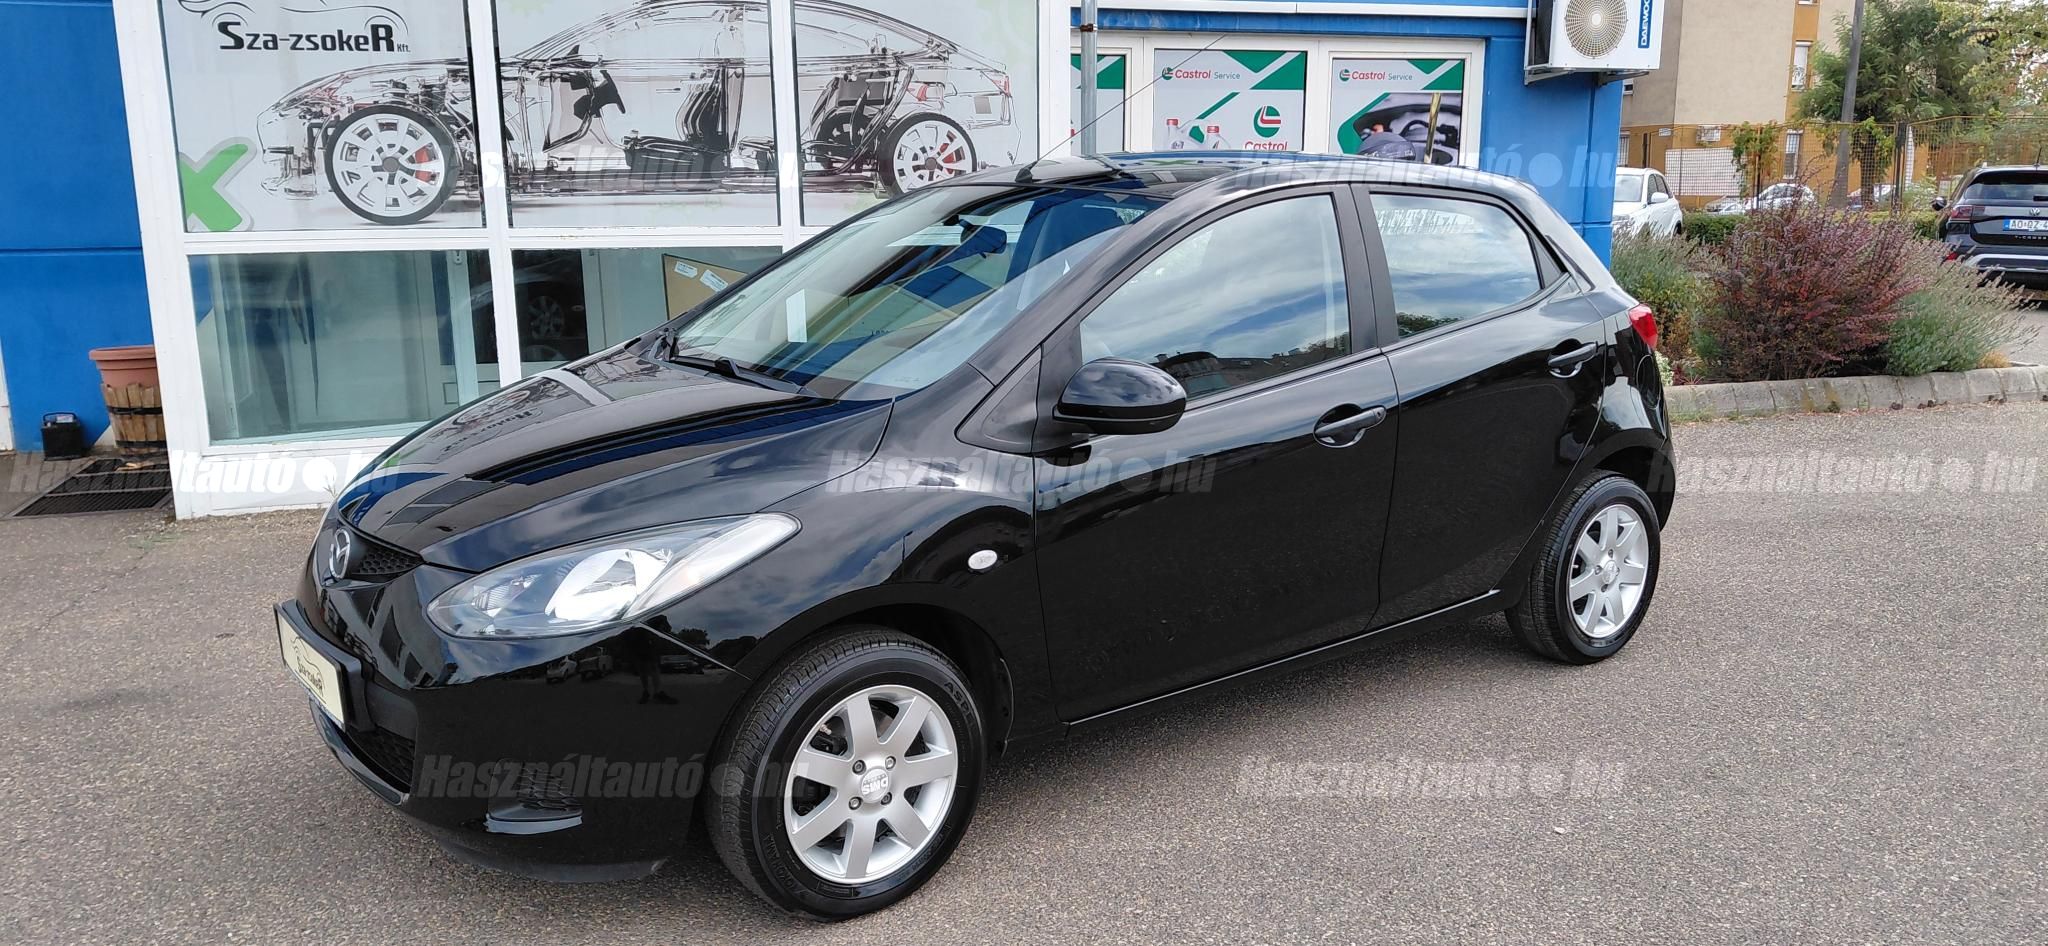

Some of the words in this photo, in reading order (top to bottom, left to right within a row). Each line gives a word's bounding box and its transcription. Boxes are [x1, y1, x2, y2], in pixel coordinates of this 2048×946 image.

[217, 21, 395, 52] Sza-zsokeR
[397, 43, 411, 53] Kft.
[1175, 69, 1211, 80] Castrol
[1214, 71, 1241, 80] Service
[1352, 70, 1386, 81] Castrol
[1388, 72, 1413, 81] Service
[1245, 140, 1288, 151] Castrol
